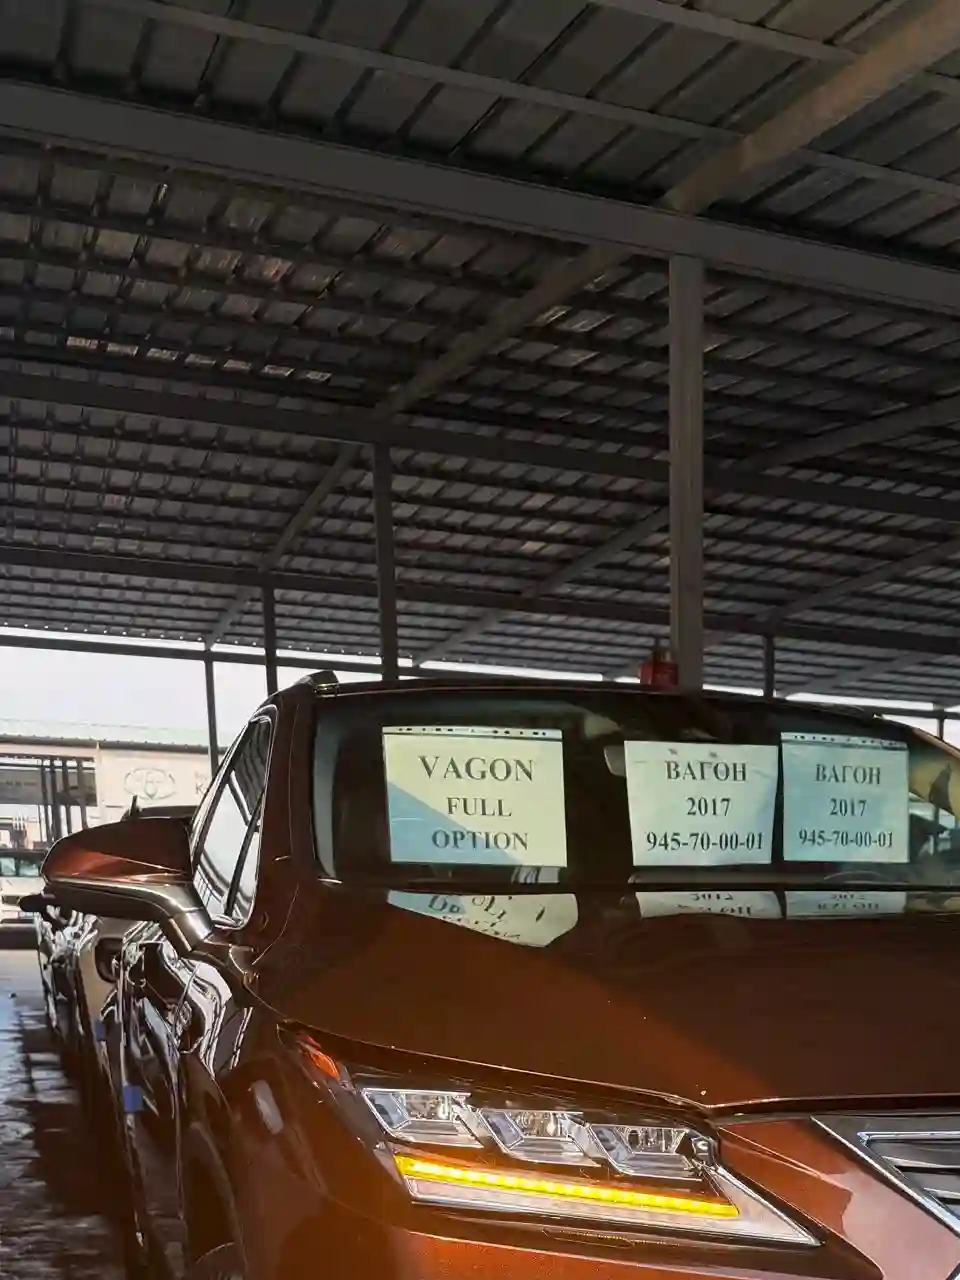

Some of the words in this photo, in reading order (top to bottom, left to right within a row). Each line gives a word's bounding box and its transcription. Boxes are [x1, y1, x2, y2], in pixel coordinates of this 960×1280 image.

[418, 755, 533, 782] VAGON
[665, 760, 747, 782] ВАГОН
[815, 764, 881, 785] ВАГОН
[446, 797, 512, 817] FULL
[686, 797, 731, 816] 2017
[829, 798, 868, 816] 2017
[432, 829, 529, 851] OPTION
[646, 831, 763, 851] 945-70-00-01
[798, 829, 894, 848] 945-70-00-01
